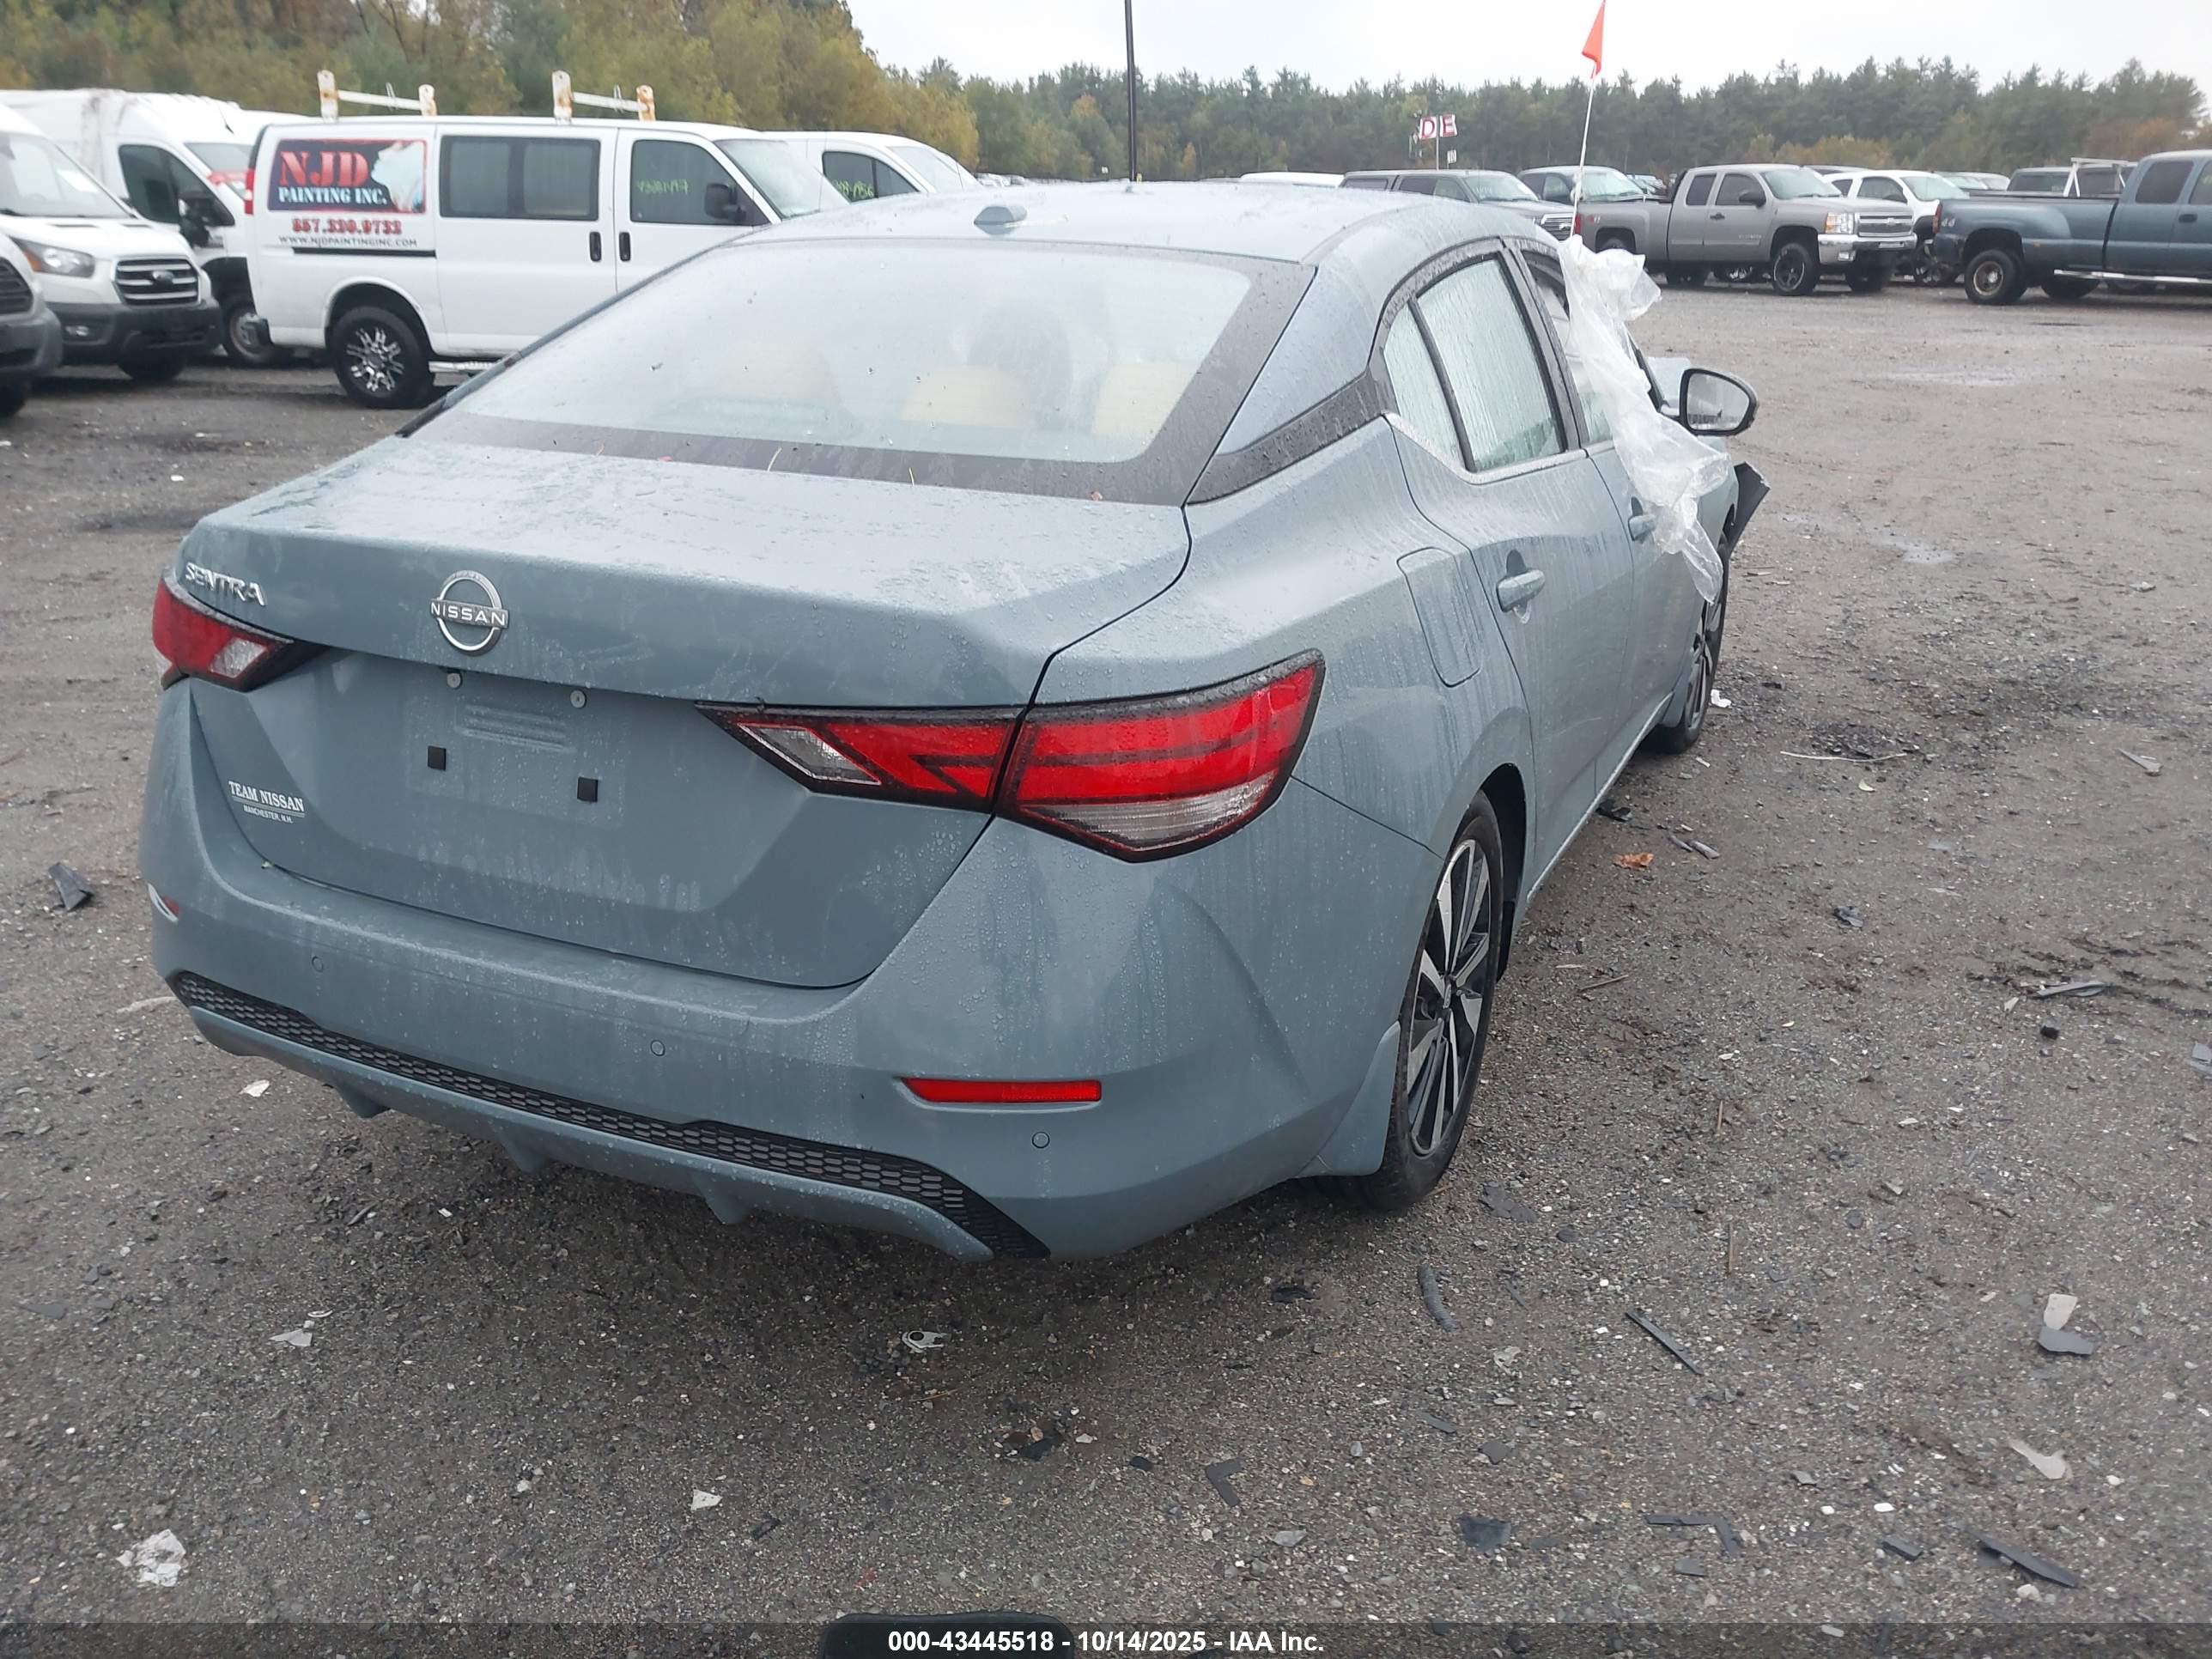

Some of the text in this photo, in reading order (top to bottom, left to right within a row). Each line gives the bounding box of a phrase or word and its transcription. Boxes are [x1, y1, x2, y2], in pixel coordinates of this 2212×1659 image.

[279, 151, 368, 187] NJD
[278, 186, 387, 205] PAINTING INC.
[185, 562, 265, 606] SENTRA
[431, 602, 505, 626] NISSAN
[228, 781, 305, 812] TEAM NISSAN
